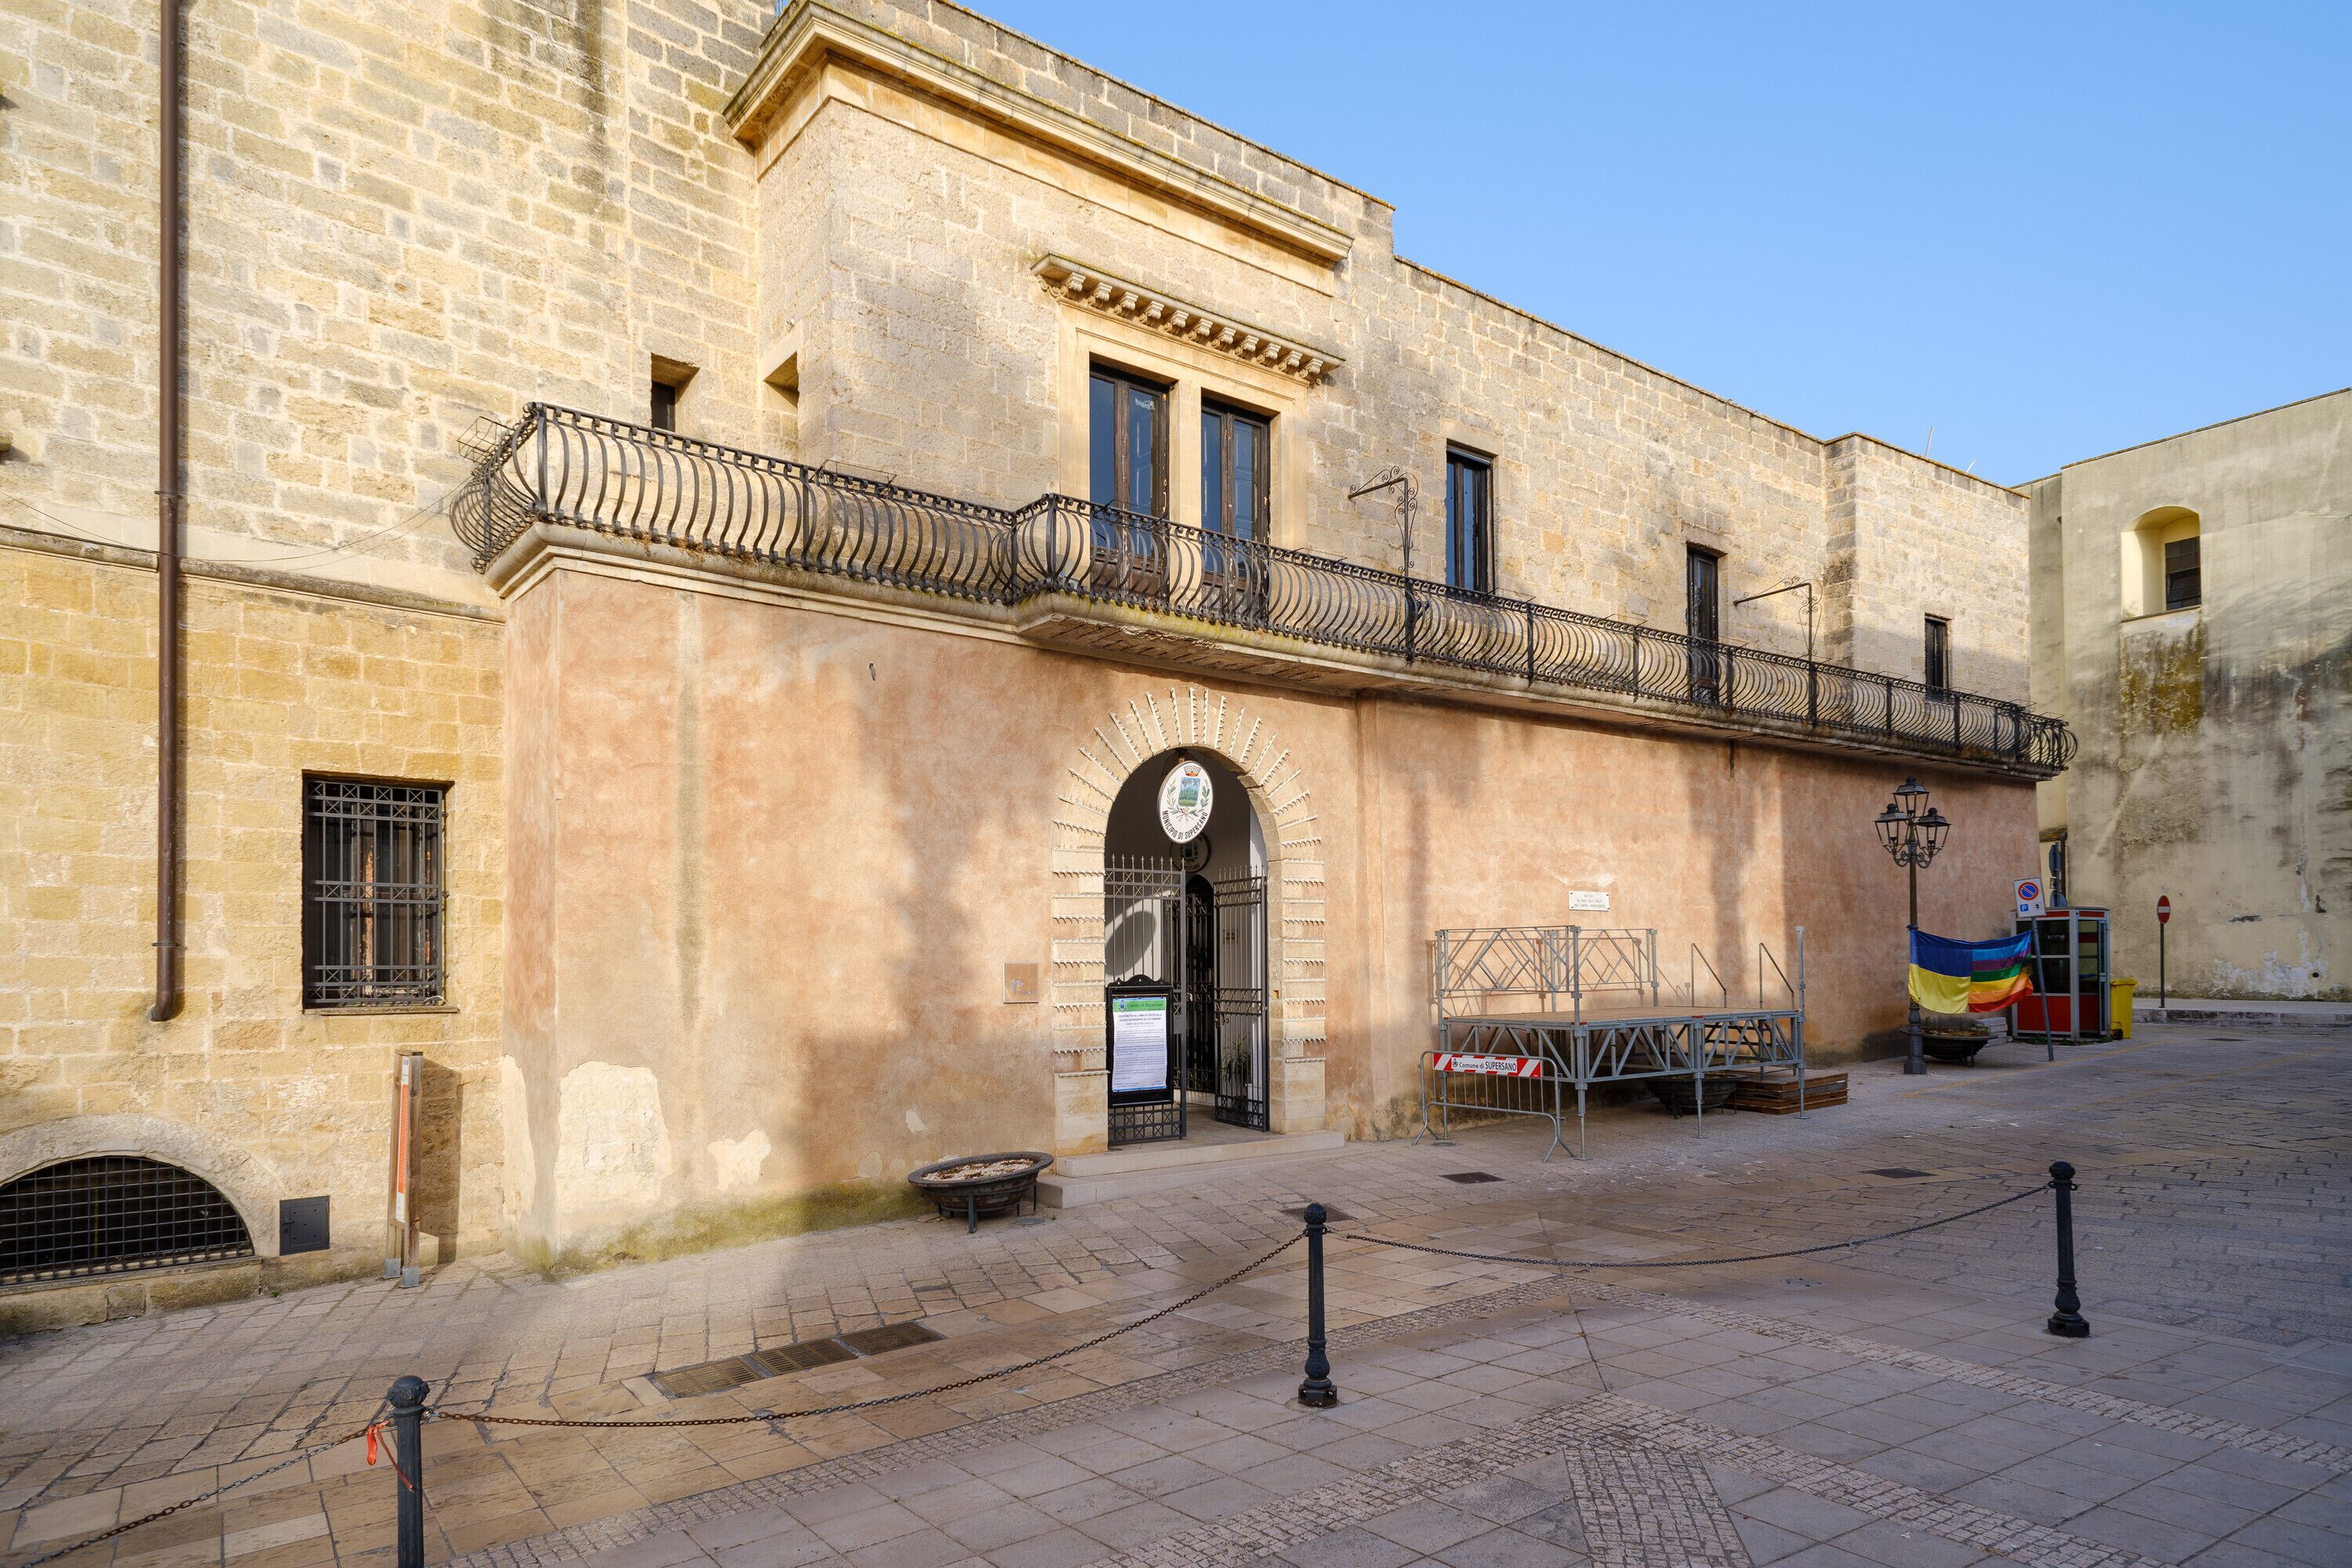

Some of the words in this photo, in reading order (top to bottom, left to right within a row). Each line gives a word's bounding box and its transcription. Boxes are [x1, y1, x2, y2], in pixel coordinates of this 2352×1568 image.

[1162, 810, 1178, 838] MUNICIPIO
[1185, 811, 1208, 840] SUPERSANO
[1485, 1061, 1516, 1072] SUPERSANO
